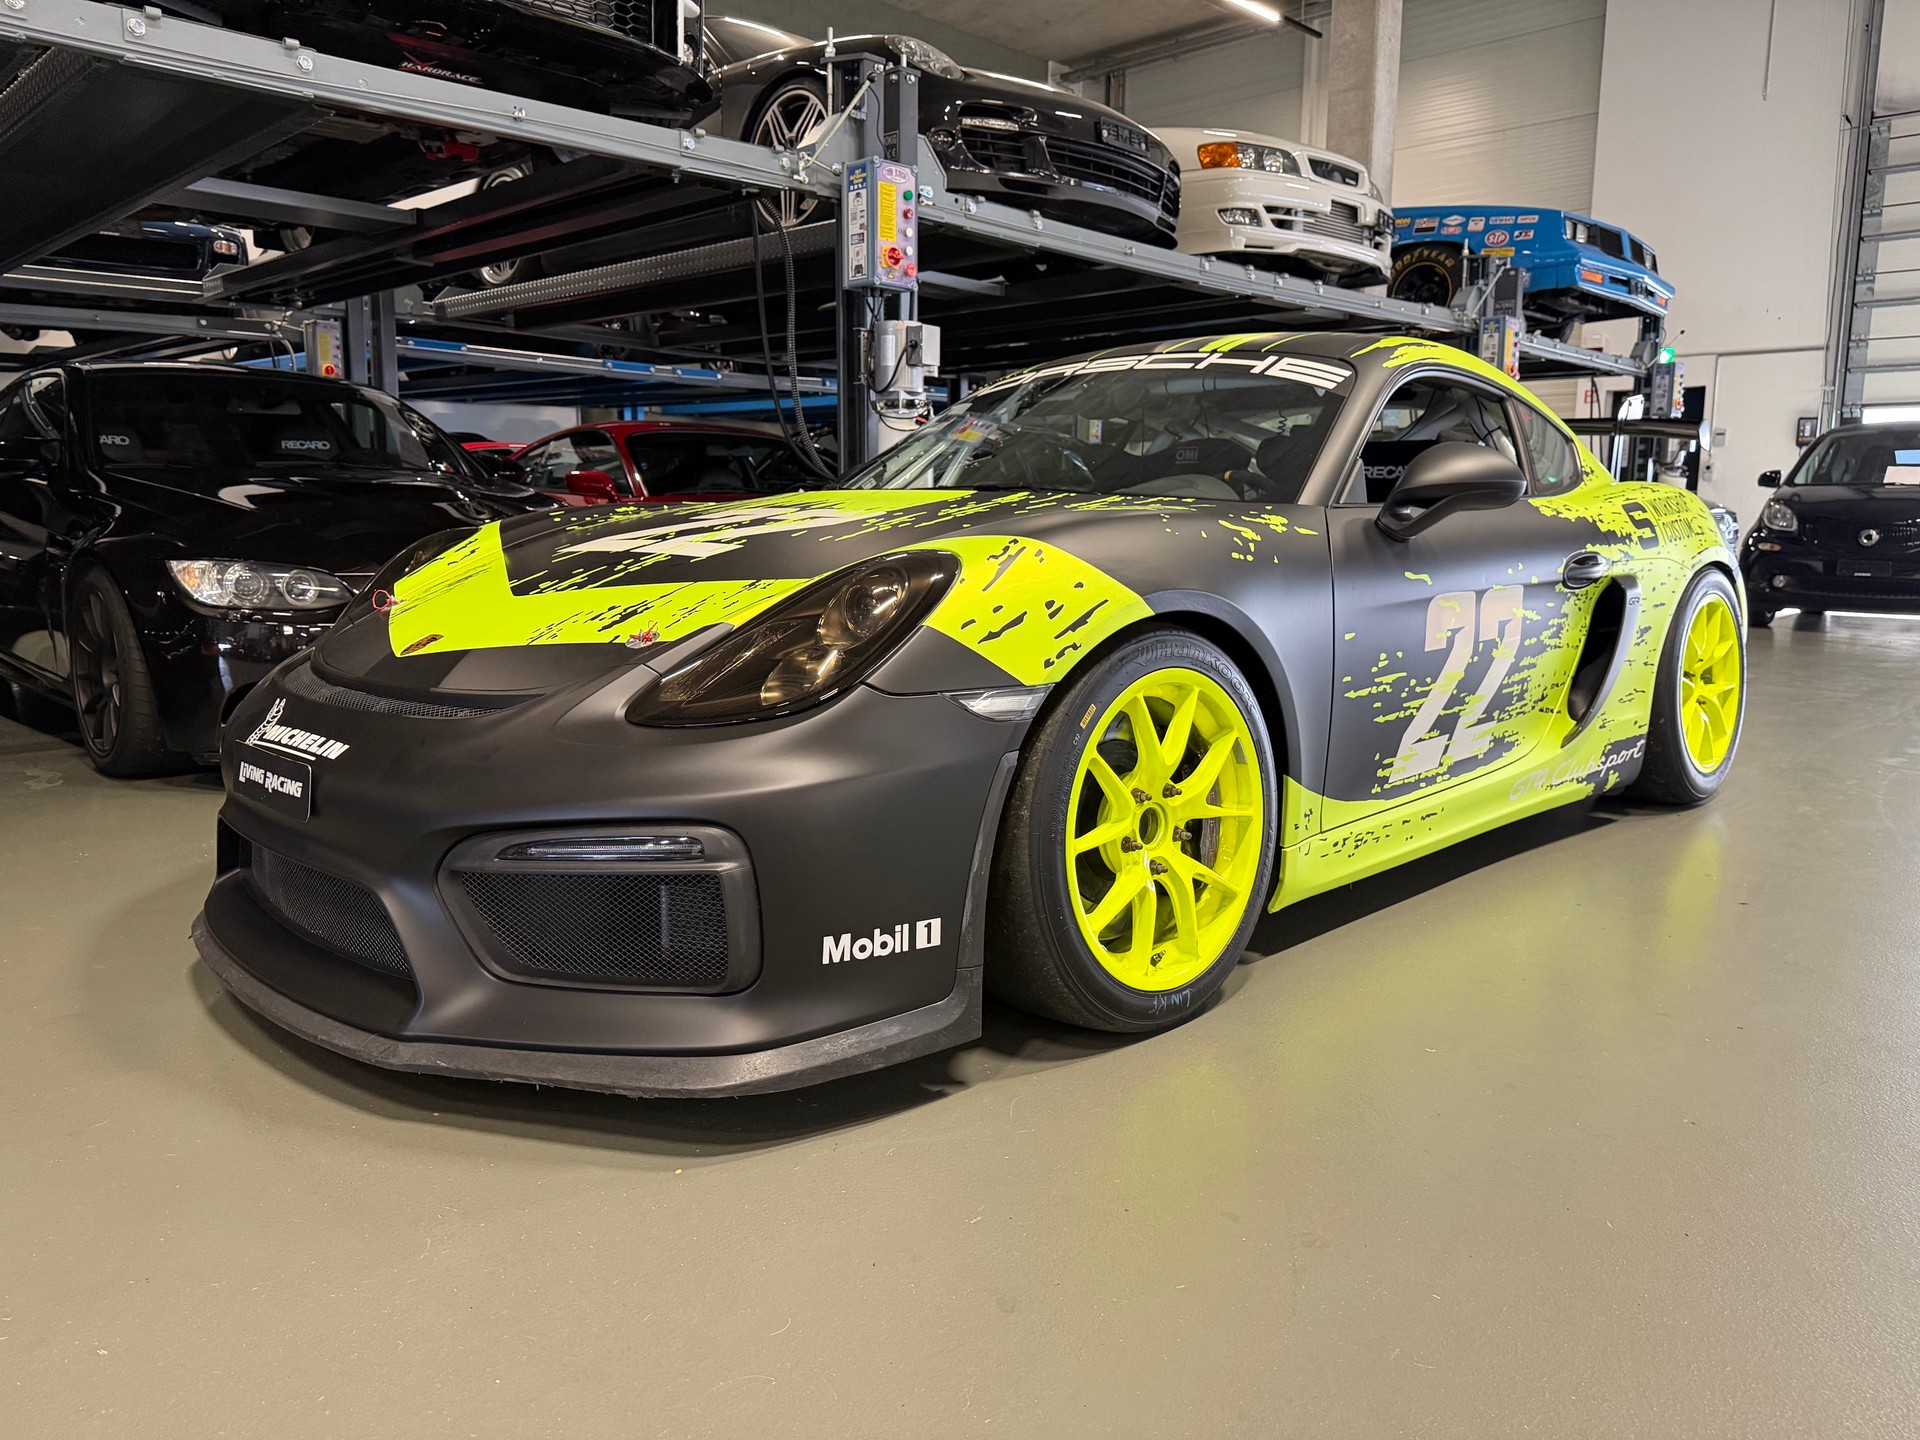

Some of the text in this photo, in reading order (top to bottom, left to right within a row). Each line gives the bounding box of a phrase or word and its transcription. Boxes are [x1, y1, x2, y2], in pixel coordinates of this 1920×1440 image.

[400, 60, 482, 83] HARDRACE
[99, 435, 130, 445] ARO
[281, 440, 331, 450] RECARO
[1362, 465, 1408, 479] RECA
[1388, 584, 1524, 784] 22
[262, 724, 350, 760] MICHELIN
[1551, 739, 1646, 785] Clubsport
[822, 917, 942, 965] Mobil 1
